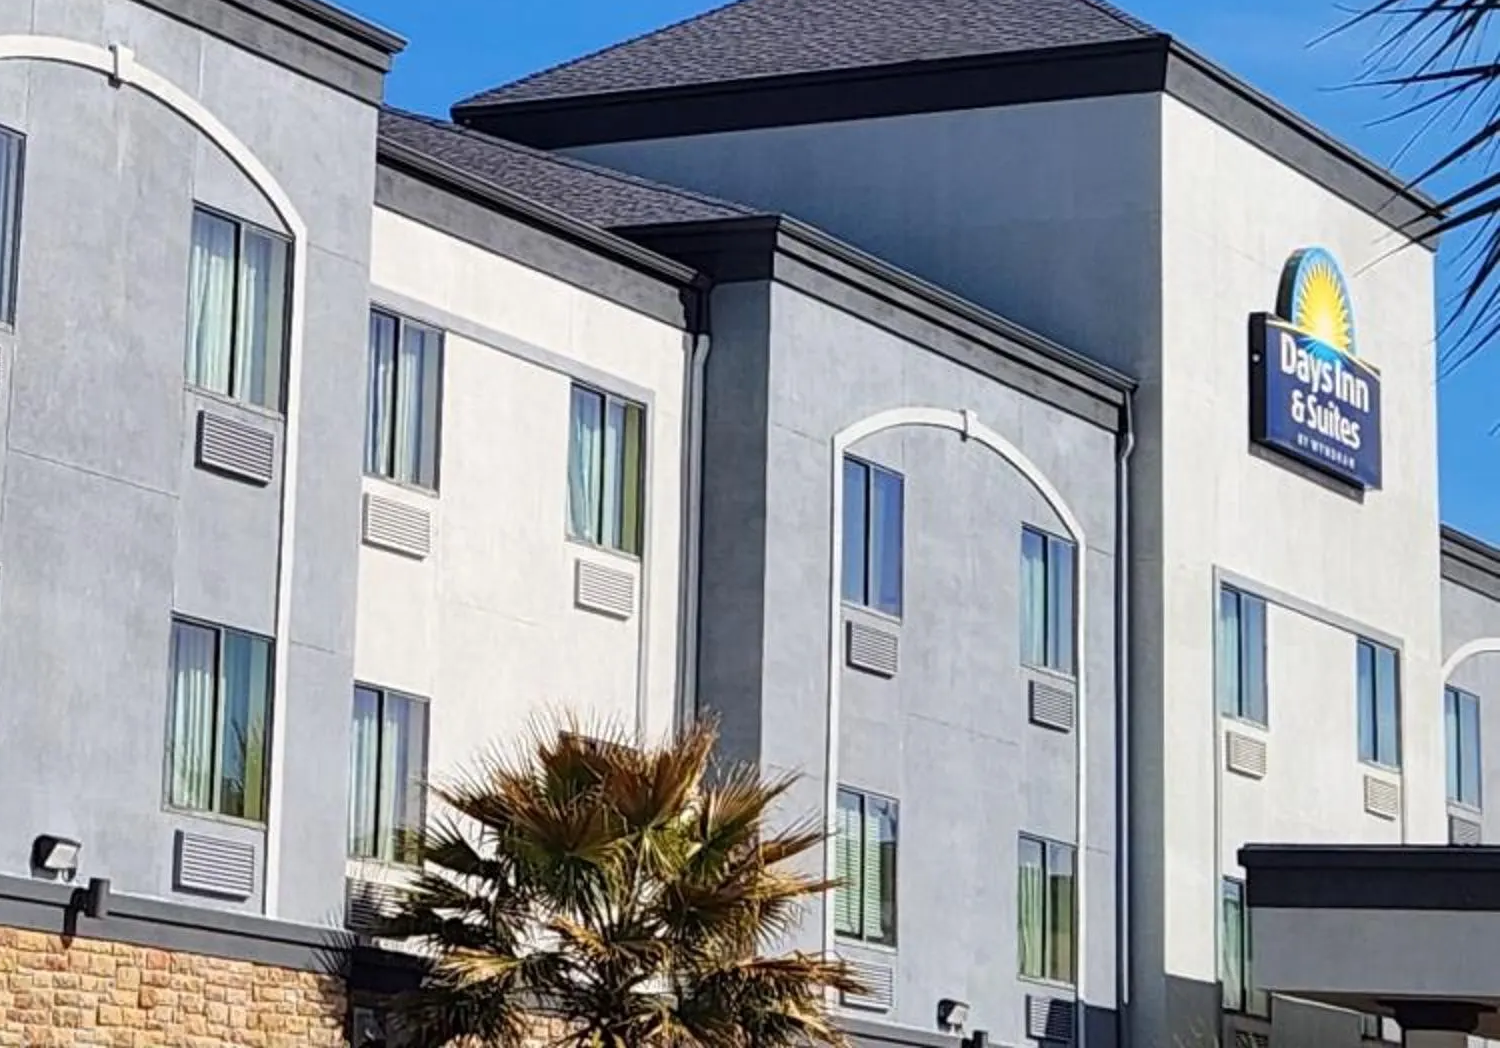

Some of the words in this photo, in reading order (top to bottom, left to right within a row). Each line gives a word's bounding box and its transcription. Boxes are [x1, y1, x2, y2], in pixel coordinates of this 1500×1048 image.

[1279, 331, 1333, 394] Days
[1335, 358, 1370, 413] Inn
[1291, 389, 1304, 424] &
[1307, 395, 1361, 450] Suites
